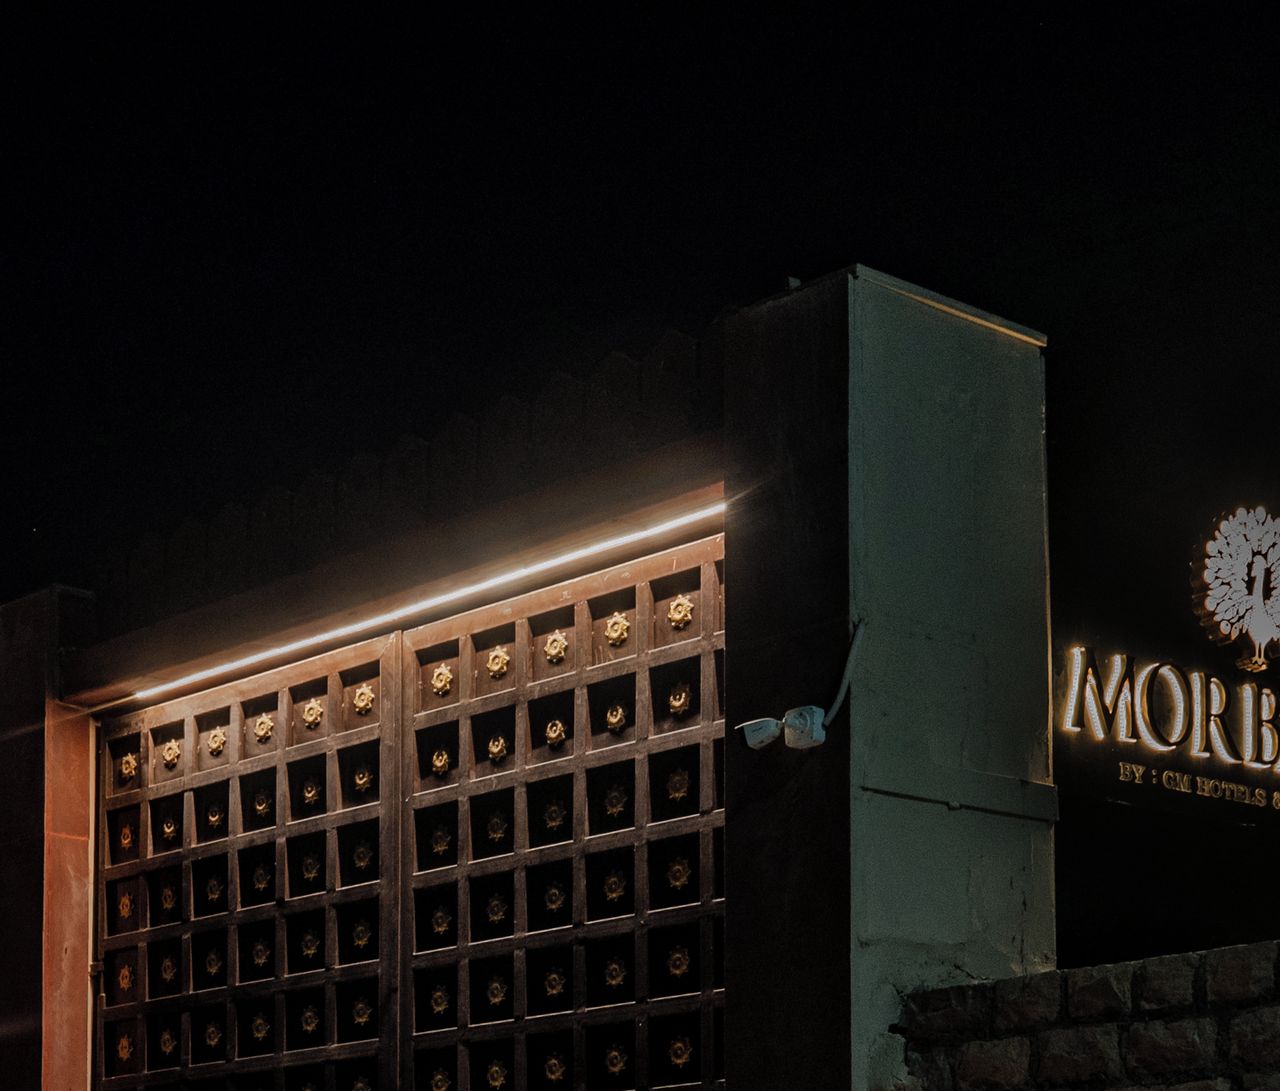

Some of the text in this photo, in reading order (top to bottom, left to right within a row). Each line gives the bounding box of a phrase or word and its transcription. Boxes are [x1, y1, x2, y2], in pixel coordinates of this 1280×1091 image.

[1119, 761, 1146, 784] BY
[1162, 770, 1193, 793] GM
[1196, 776, 1267, 807] HOTELS
